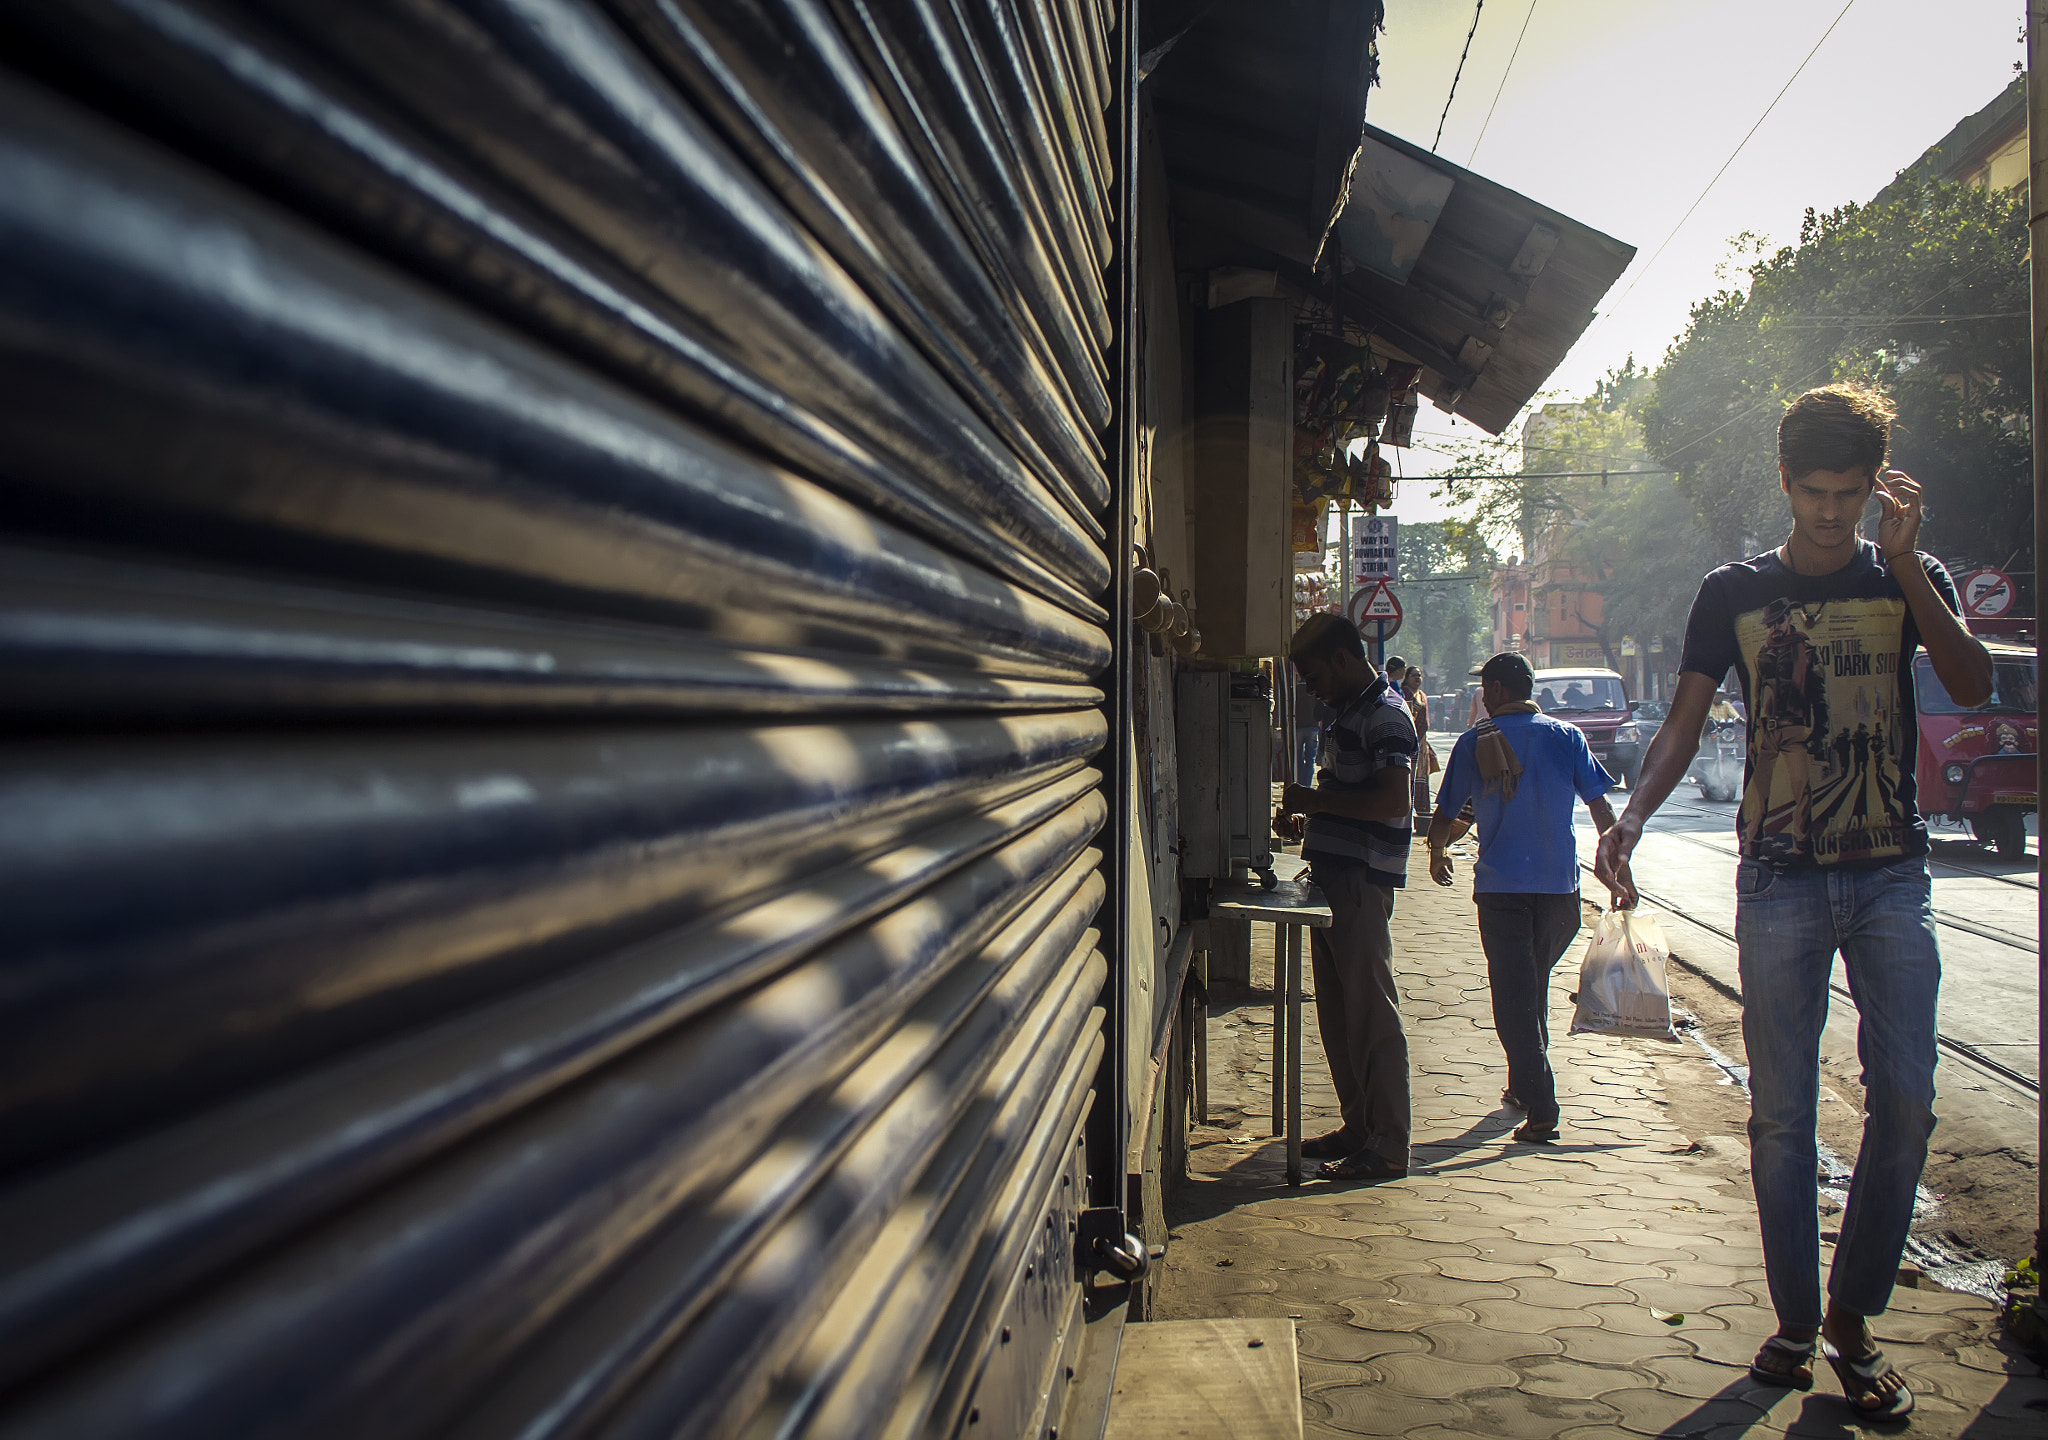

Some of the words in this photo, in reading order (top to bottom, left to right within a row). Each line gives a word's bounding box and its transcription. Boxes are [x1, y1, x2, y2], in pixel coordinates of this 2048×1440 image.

[1361, 536, 1377, 545] WAY
[1379, 536, 1389, 545] TO
[1355, 547, 1383, 558] HOWRAH
[1361, 562, 1388, 572] STATION
[1830, 640, 1843, 654] TO
[1845, 639, 1863, 653] THE
[1834, 654, 1871, 677] DARK
